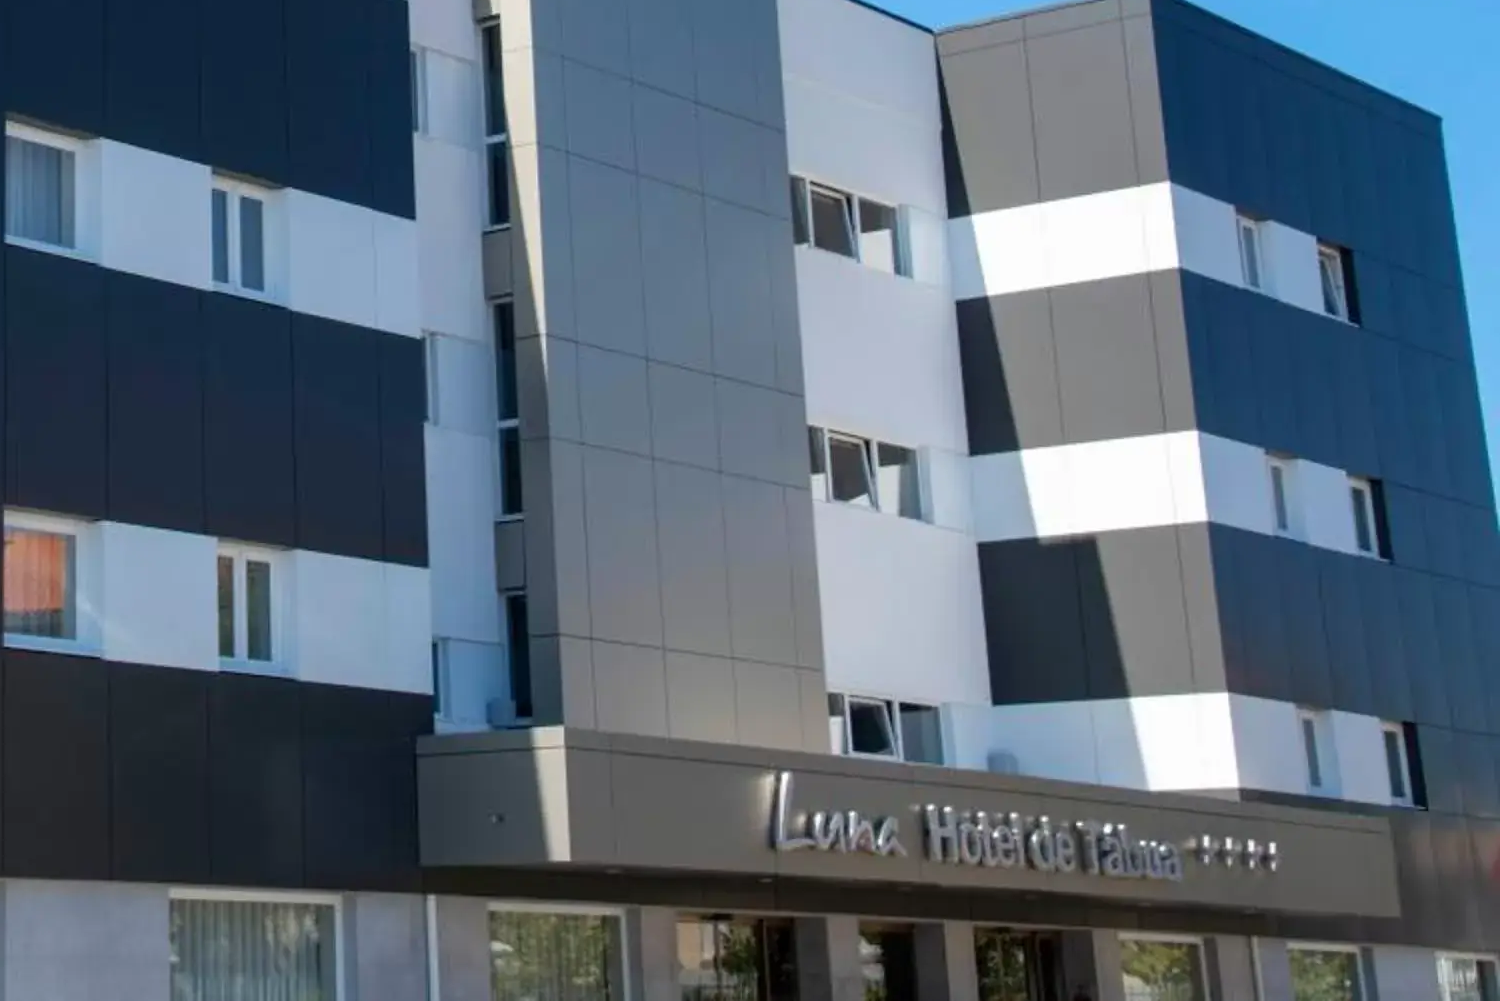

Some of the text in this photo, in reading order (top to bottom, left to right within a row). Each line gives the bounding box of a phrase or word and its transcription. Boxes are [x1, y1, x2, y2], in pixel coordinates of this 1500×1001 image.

[774, 770, 1184, 883] Luna Hotel de Tábua
